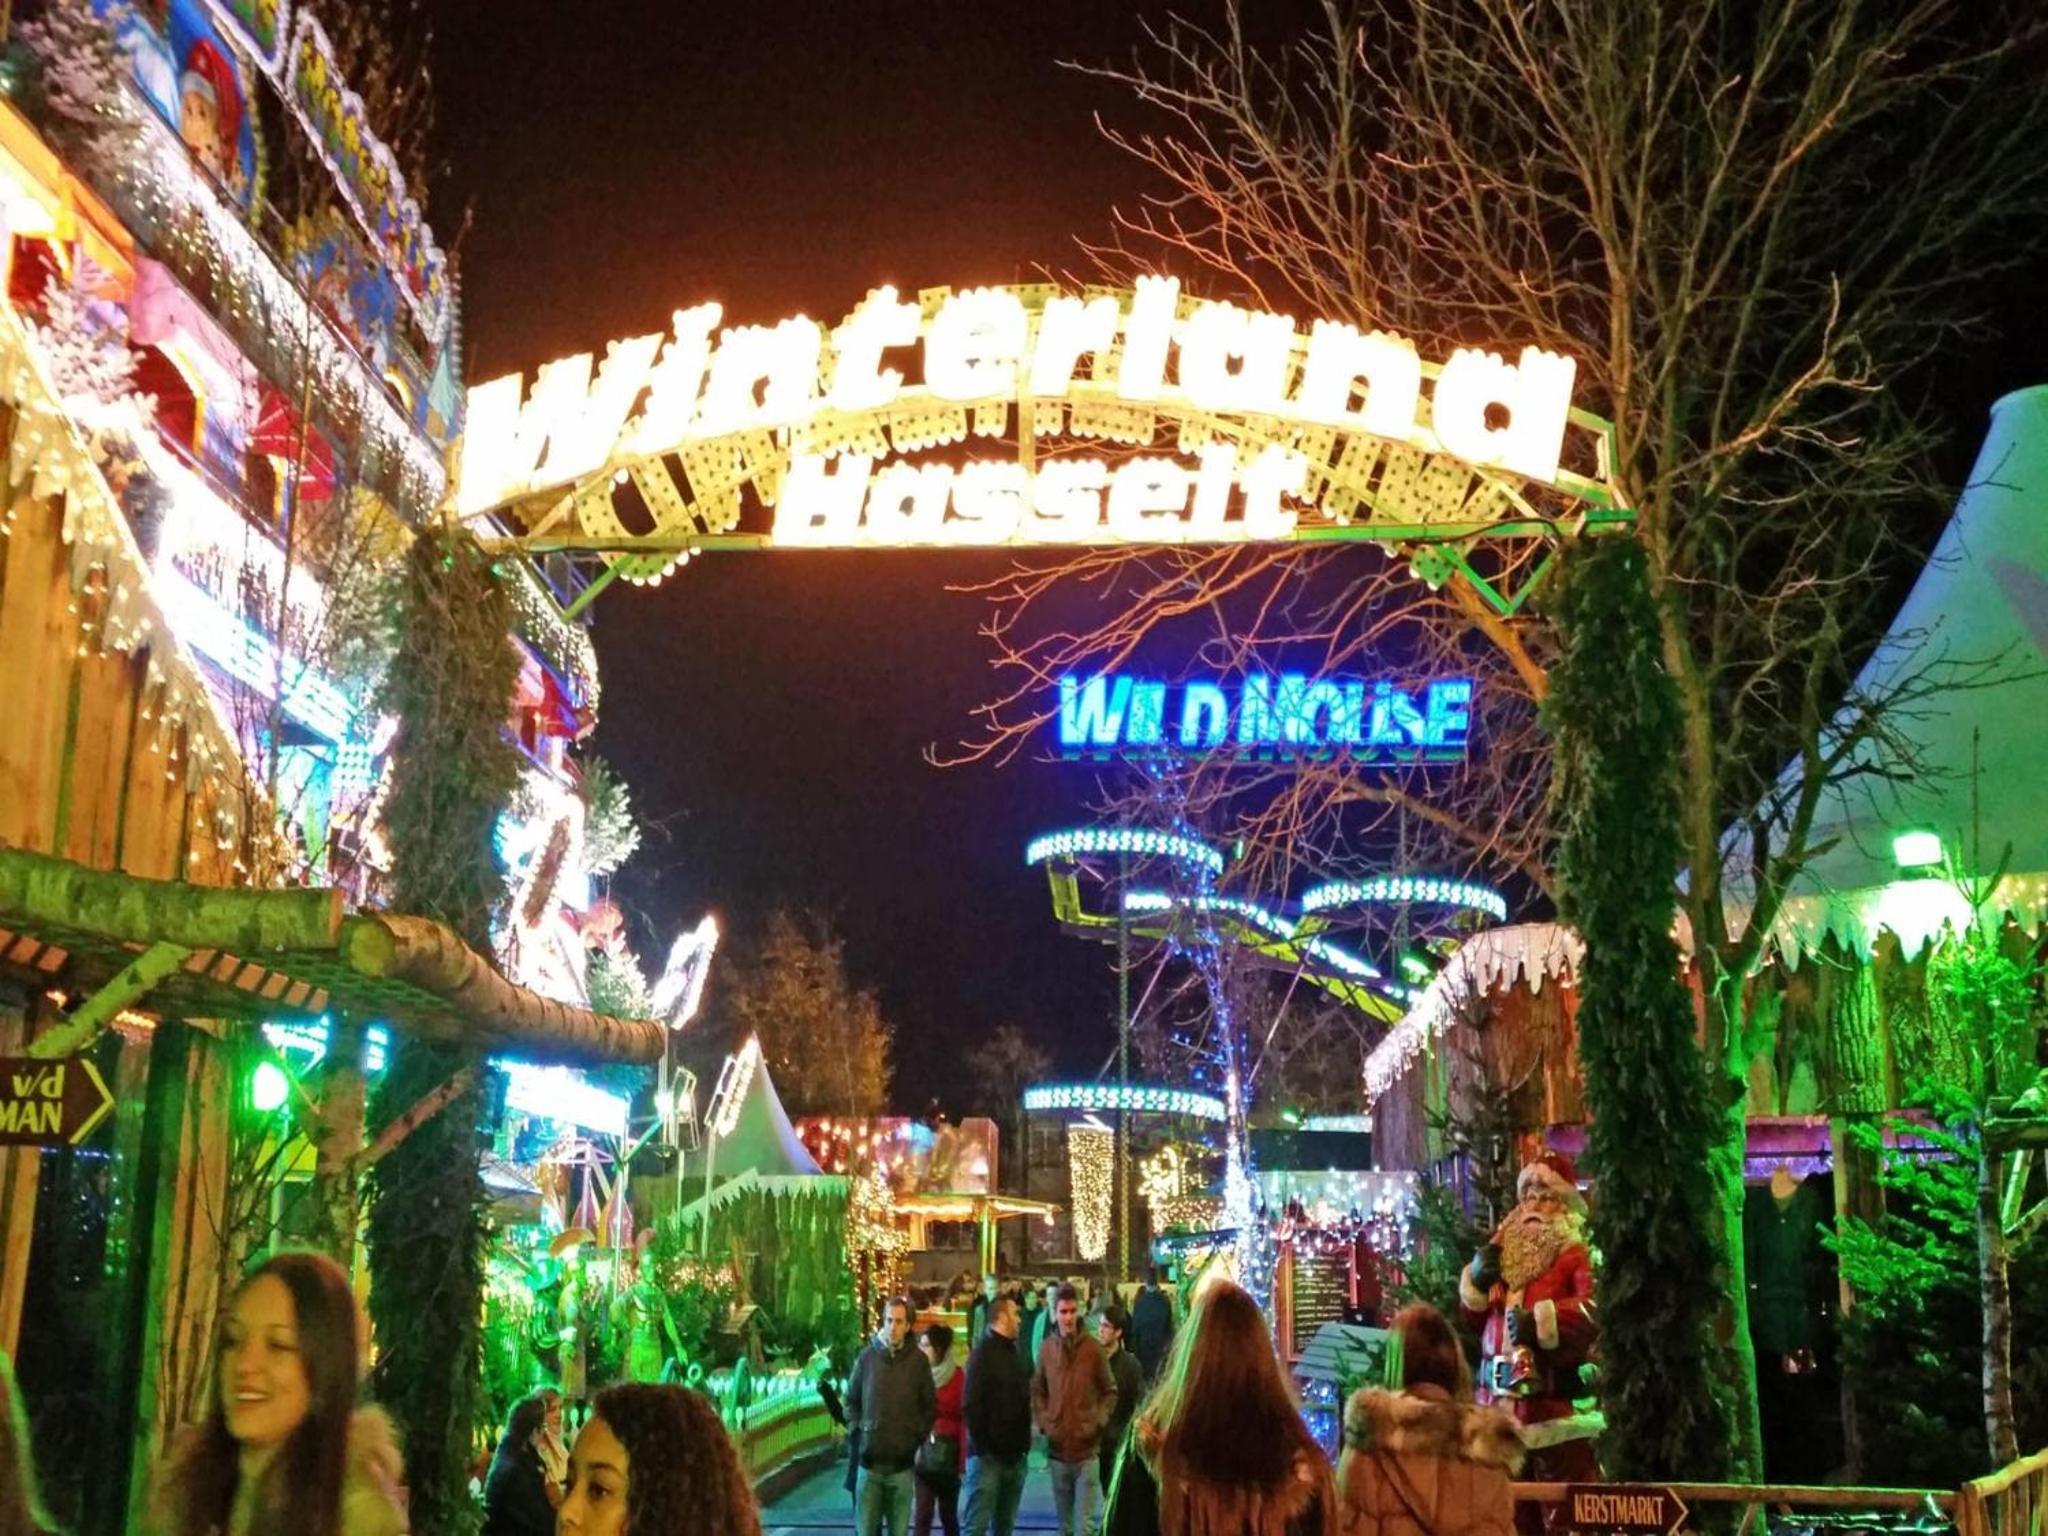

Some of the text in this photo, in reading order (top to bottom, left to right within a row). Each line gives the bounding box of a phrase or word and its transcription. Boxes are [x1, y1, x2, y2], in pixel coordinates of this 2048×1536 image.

[457, 276, 1577, 518] Winterland
[770, 447, 1306, 549] Hasselt
[1059, 674, 1474, 761] WILD MOUSE
[12, 1064, 65, 1098] v/d
[1574, 1494, 1664, 1525] KERSTMARKT
